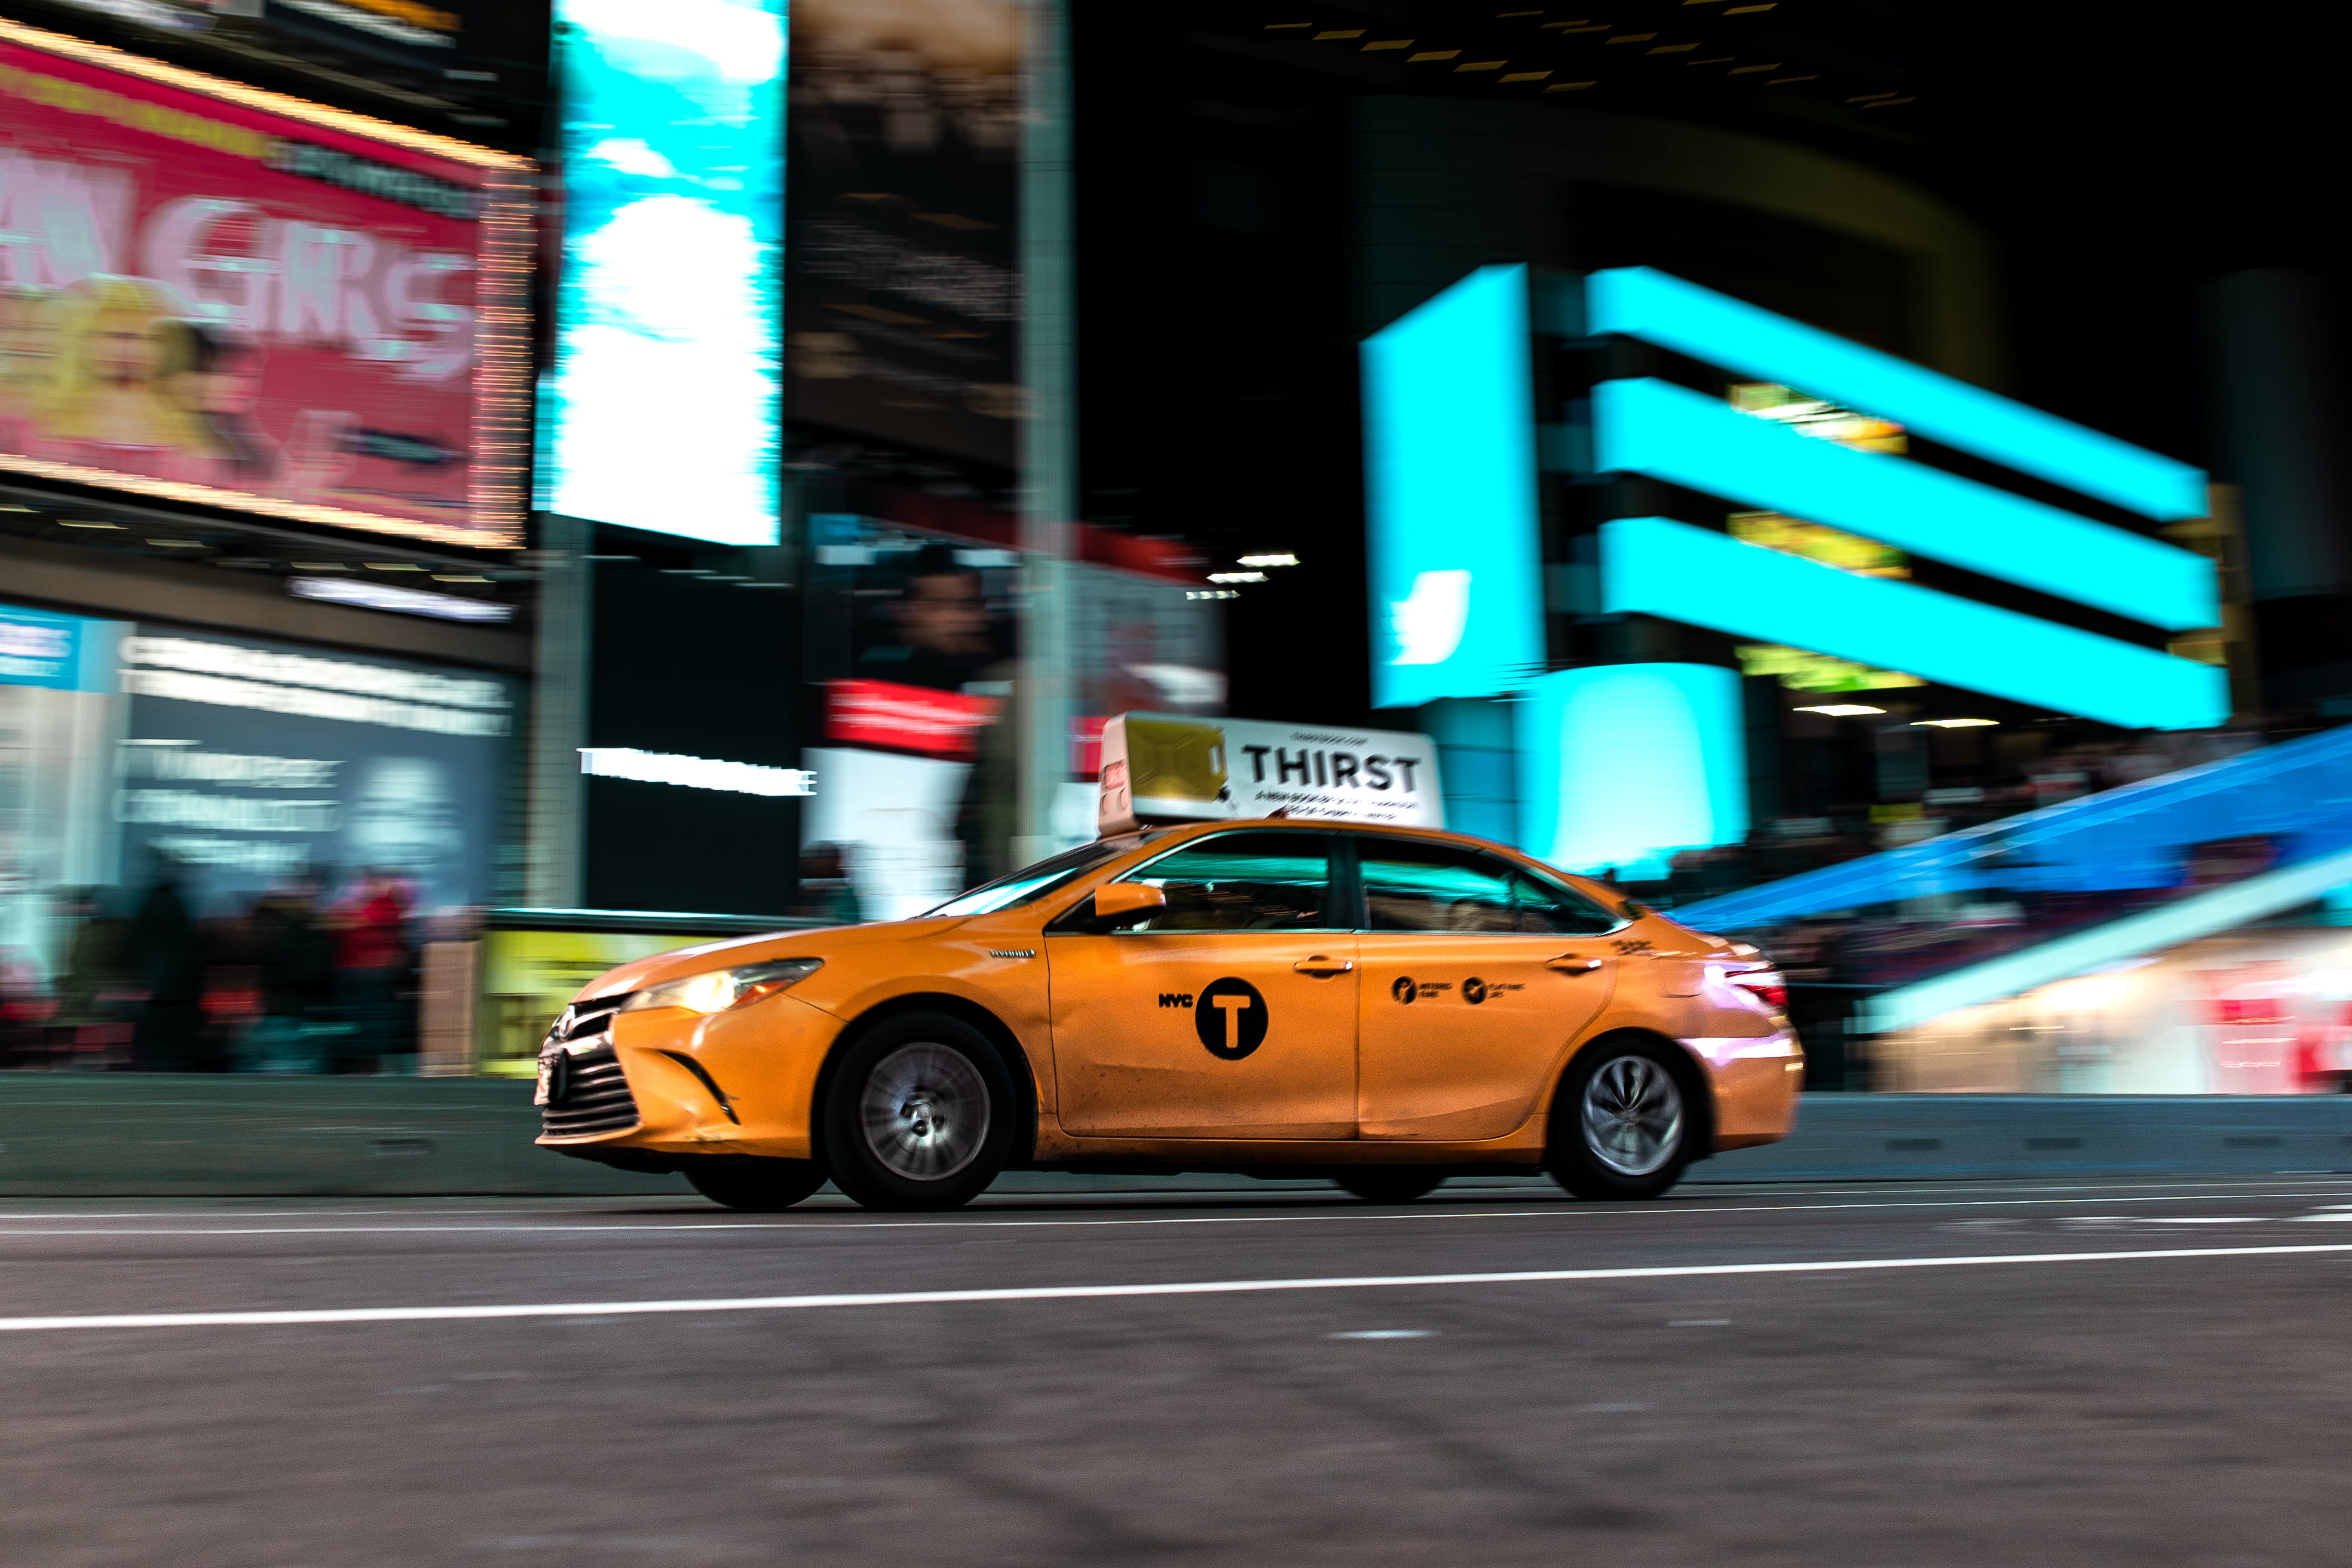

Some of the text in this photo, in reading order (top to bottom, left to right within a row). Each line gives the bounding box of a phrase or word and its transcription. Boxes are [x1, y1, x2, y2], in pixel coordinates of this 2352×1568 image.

[1242, 744, 1421, 794] THIRST
[1158, 994, 1251, 1048] NYC T
